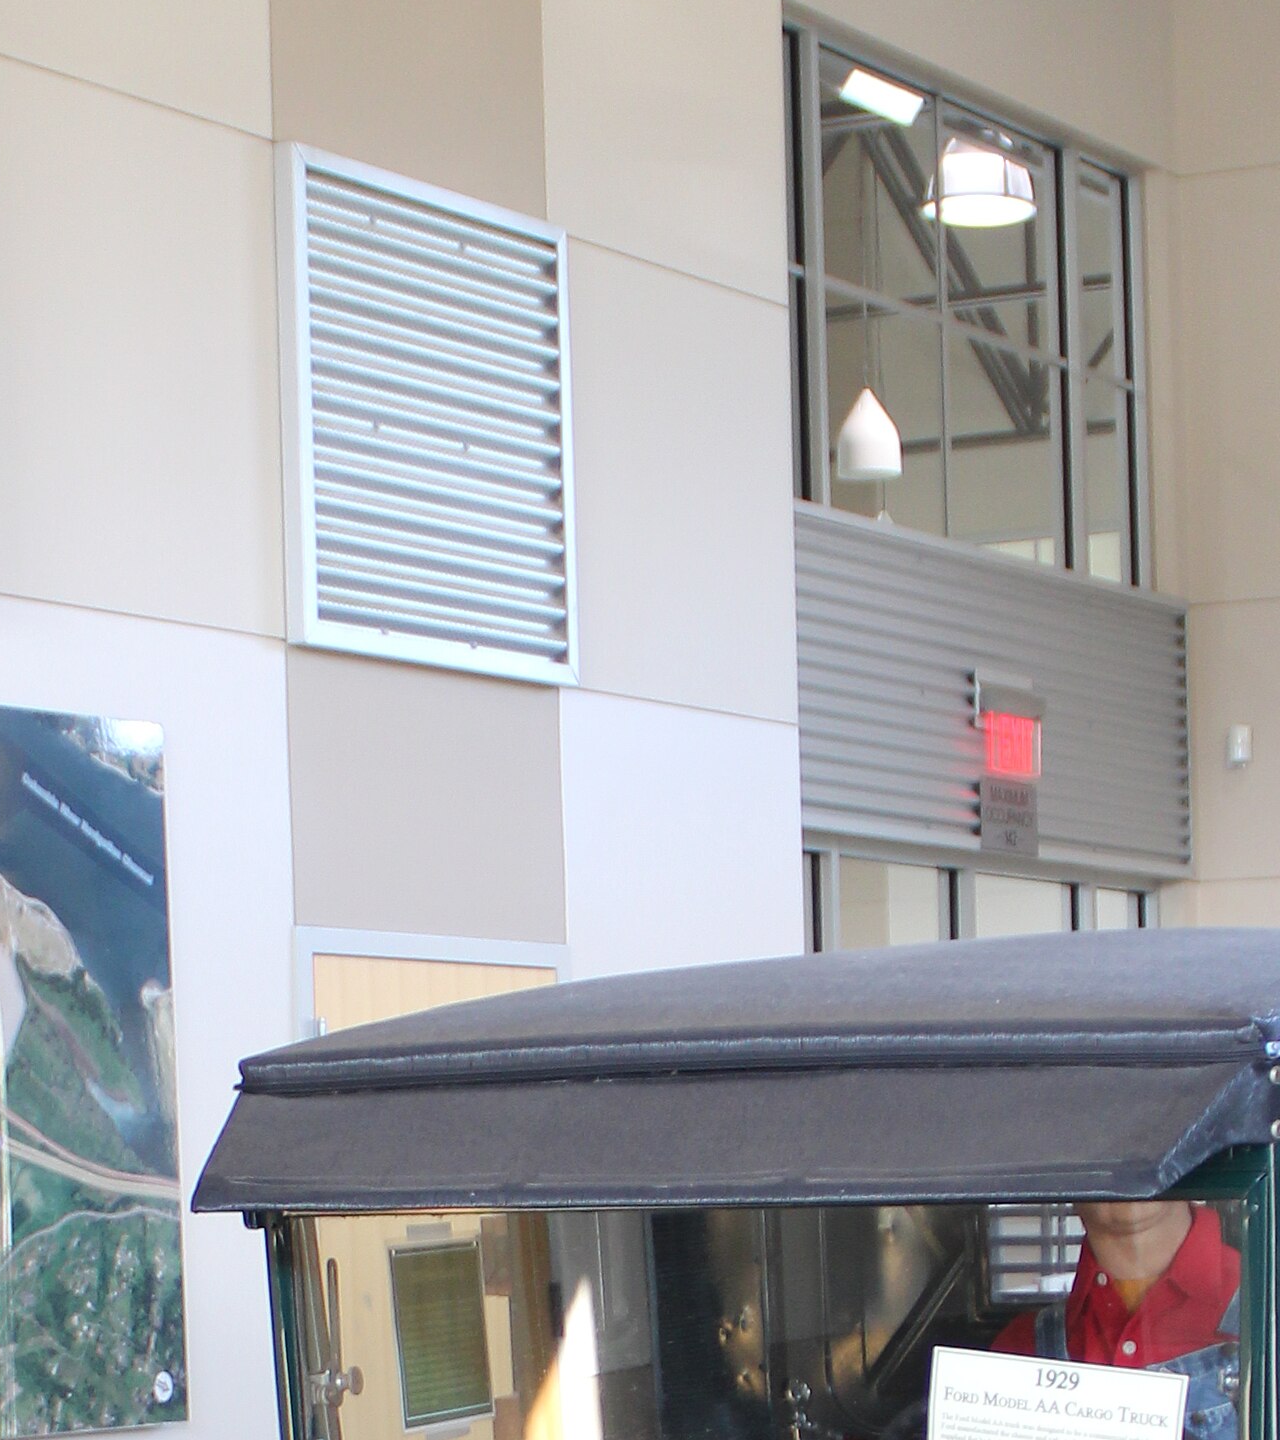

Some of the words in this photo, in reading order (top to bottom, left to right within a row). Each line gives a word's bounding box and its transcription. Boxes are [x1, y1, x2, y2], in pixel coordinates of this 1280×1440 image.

[997, 714, 1034, 773] EXIT
[1035, 1367, 1080, 1391] 1929
[943, 1386, 979, 1405] FORD
[982, 1391, 1031, 1412] MODEL
[1035, 1399, 1060, 1415] AA
[1065, 1402, 1113, 1421] CARGO
[1118, 1406, 1169, 1428] TRUCK
